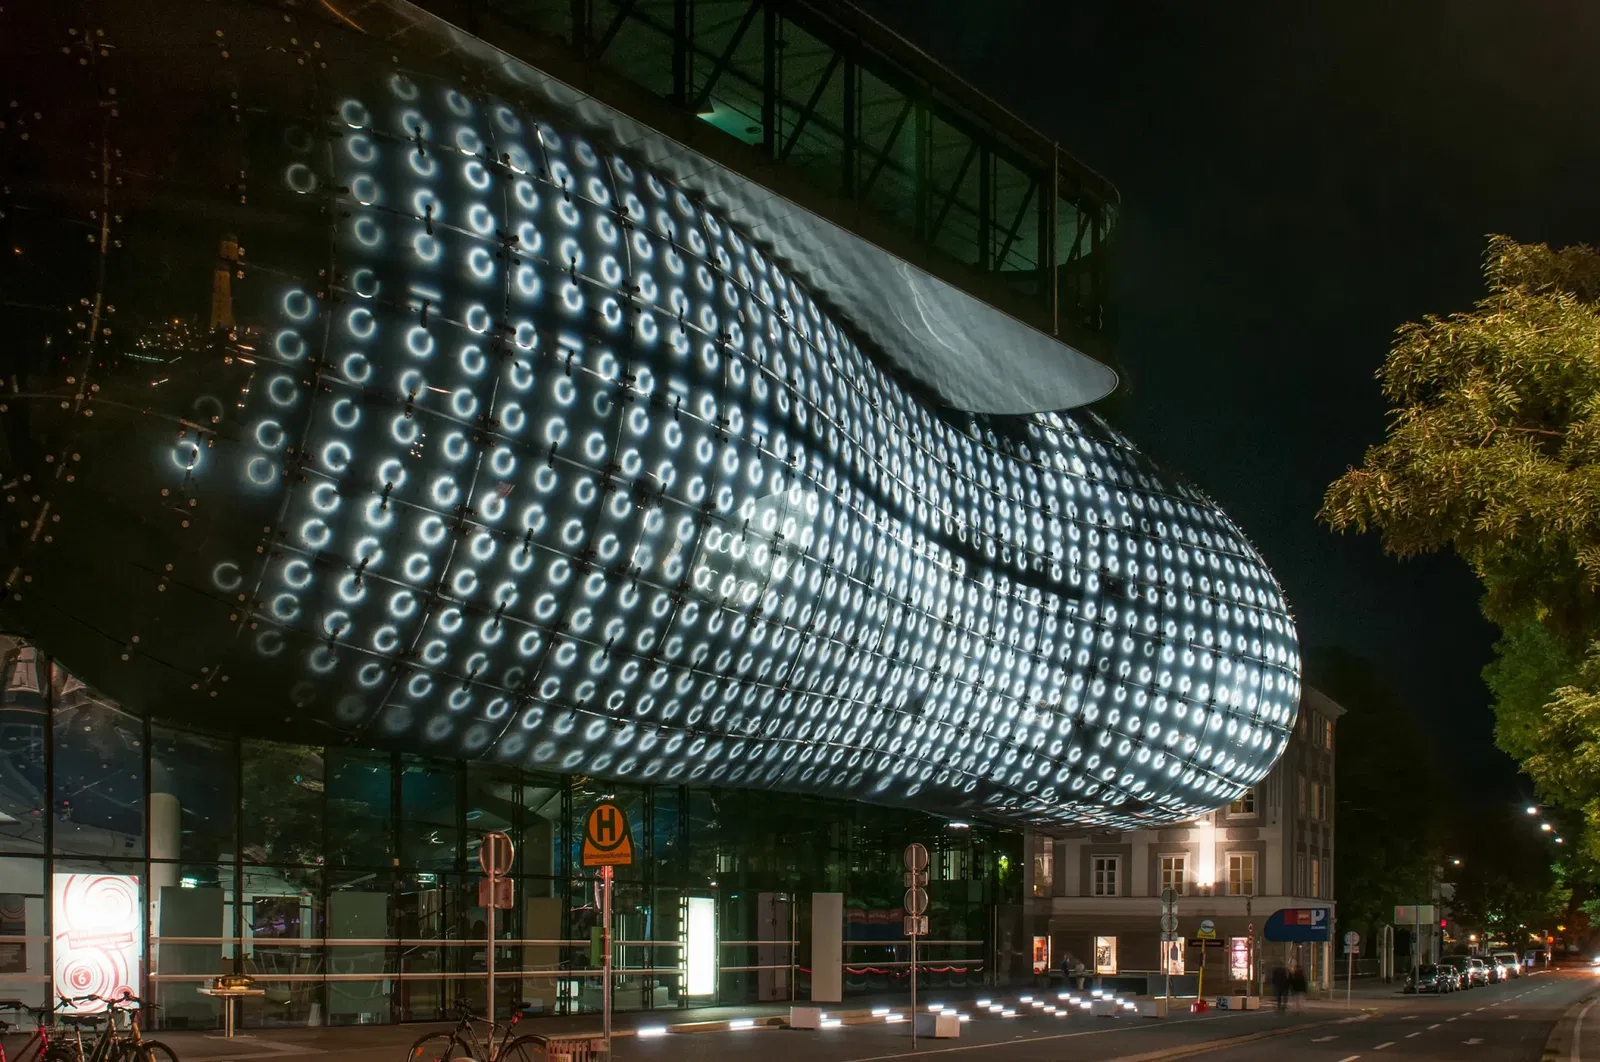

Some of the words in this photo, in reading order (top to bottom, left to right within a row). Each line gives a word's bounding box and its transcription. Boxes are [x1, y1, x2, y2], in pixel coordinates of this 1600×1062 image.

[597, 809, 615, 841] H
[1311, 910, 1325, 925] P
[78, 973, 87, 985] 6
